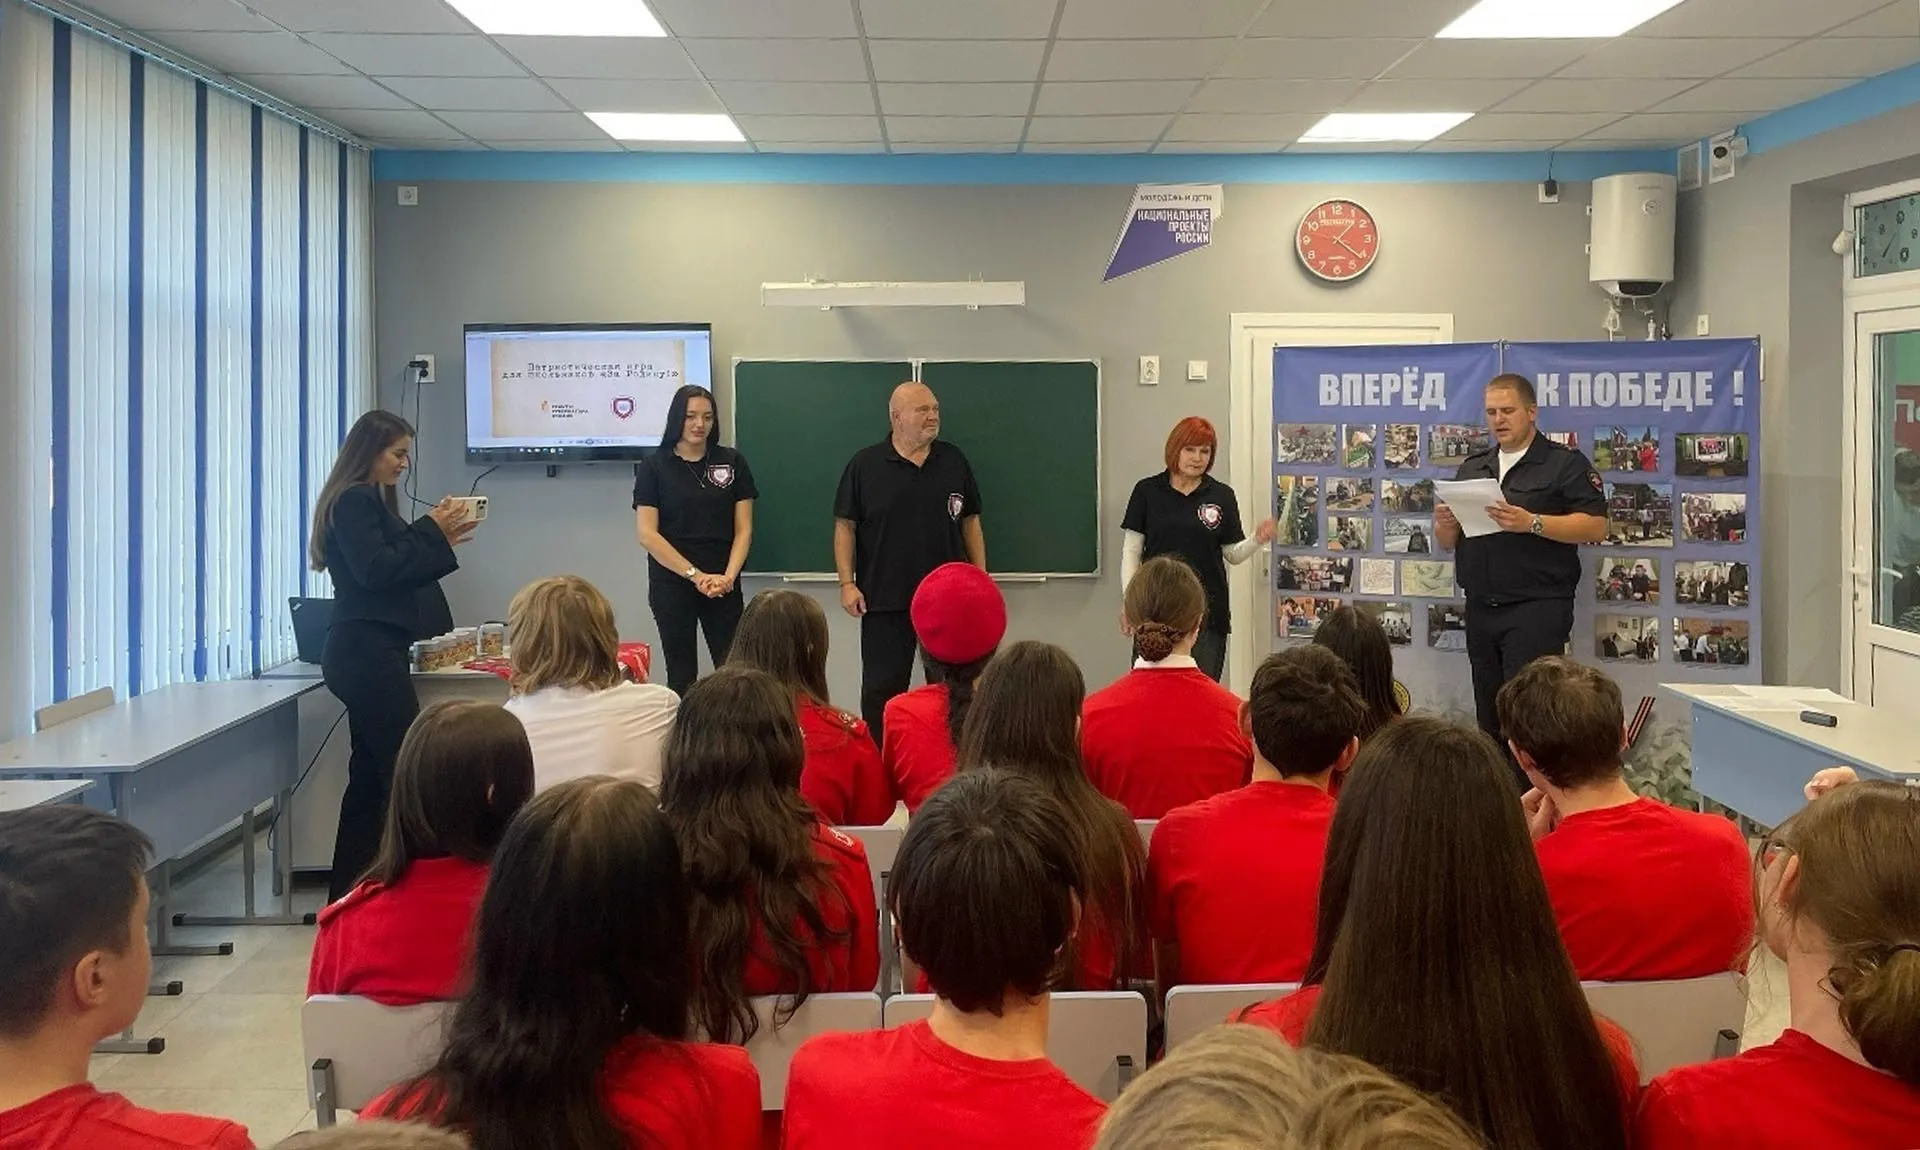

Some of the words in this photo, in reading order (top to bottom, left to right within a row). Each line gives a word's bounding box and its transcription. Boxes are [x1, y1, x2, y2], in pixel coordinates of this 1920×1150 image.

[1138, 209, 1209, 221] НАЦИОНАЛЬНЫЕ
[1318, 210, 1326, 218] 11
[1332, 205, 1342, 215] 12
[1351, 209, 1355, 217] 1
[1168, 221, 1209, 232] ПРОЕКТЫ
[1308, 221, 1319, 231] 10
[1359, 219, 1367, 228] 2
[1175, 232, 1209, 243] РОССИИ
[1303, 235, 1311, 245] 9
[1364, 235, 1371, 243] 3
[1308, 250, 1316, 259] 8
[1360, 250, 1367, 258] 4
[1319, 261, 1326, 270] 7
[1333, 265, 1341, 275] 6
[1348, 260, 1356, 270] 5
[1319, 366, 1446, 411] ВПЕРЁД
[1536, 373, 1560, 407] К
[1568, 371, 1713, 412] ПОБЕДЕ
[1733, 371, 1744, 406] !
